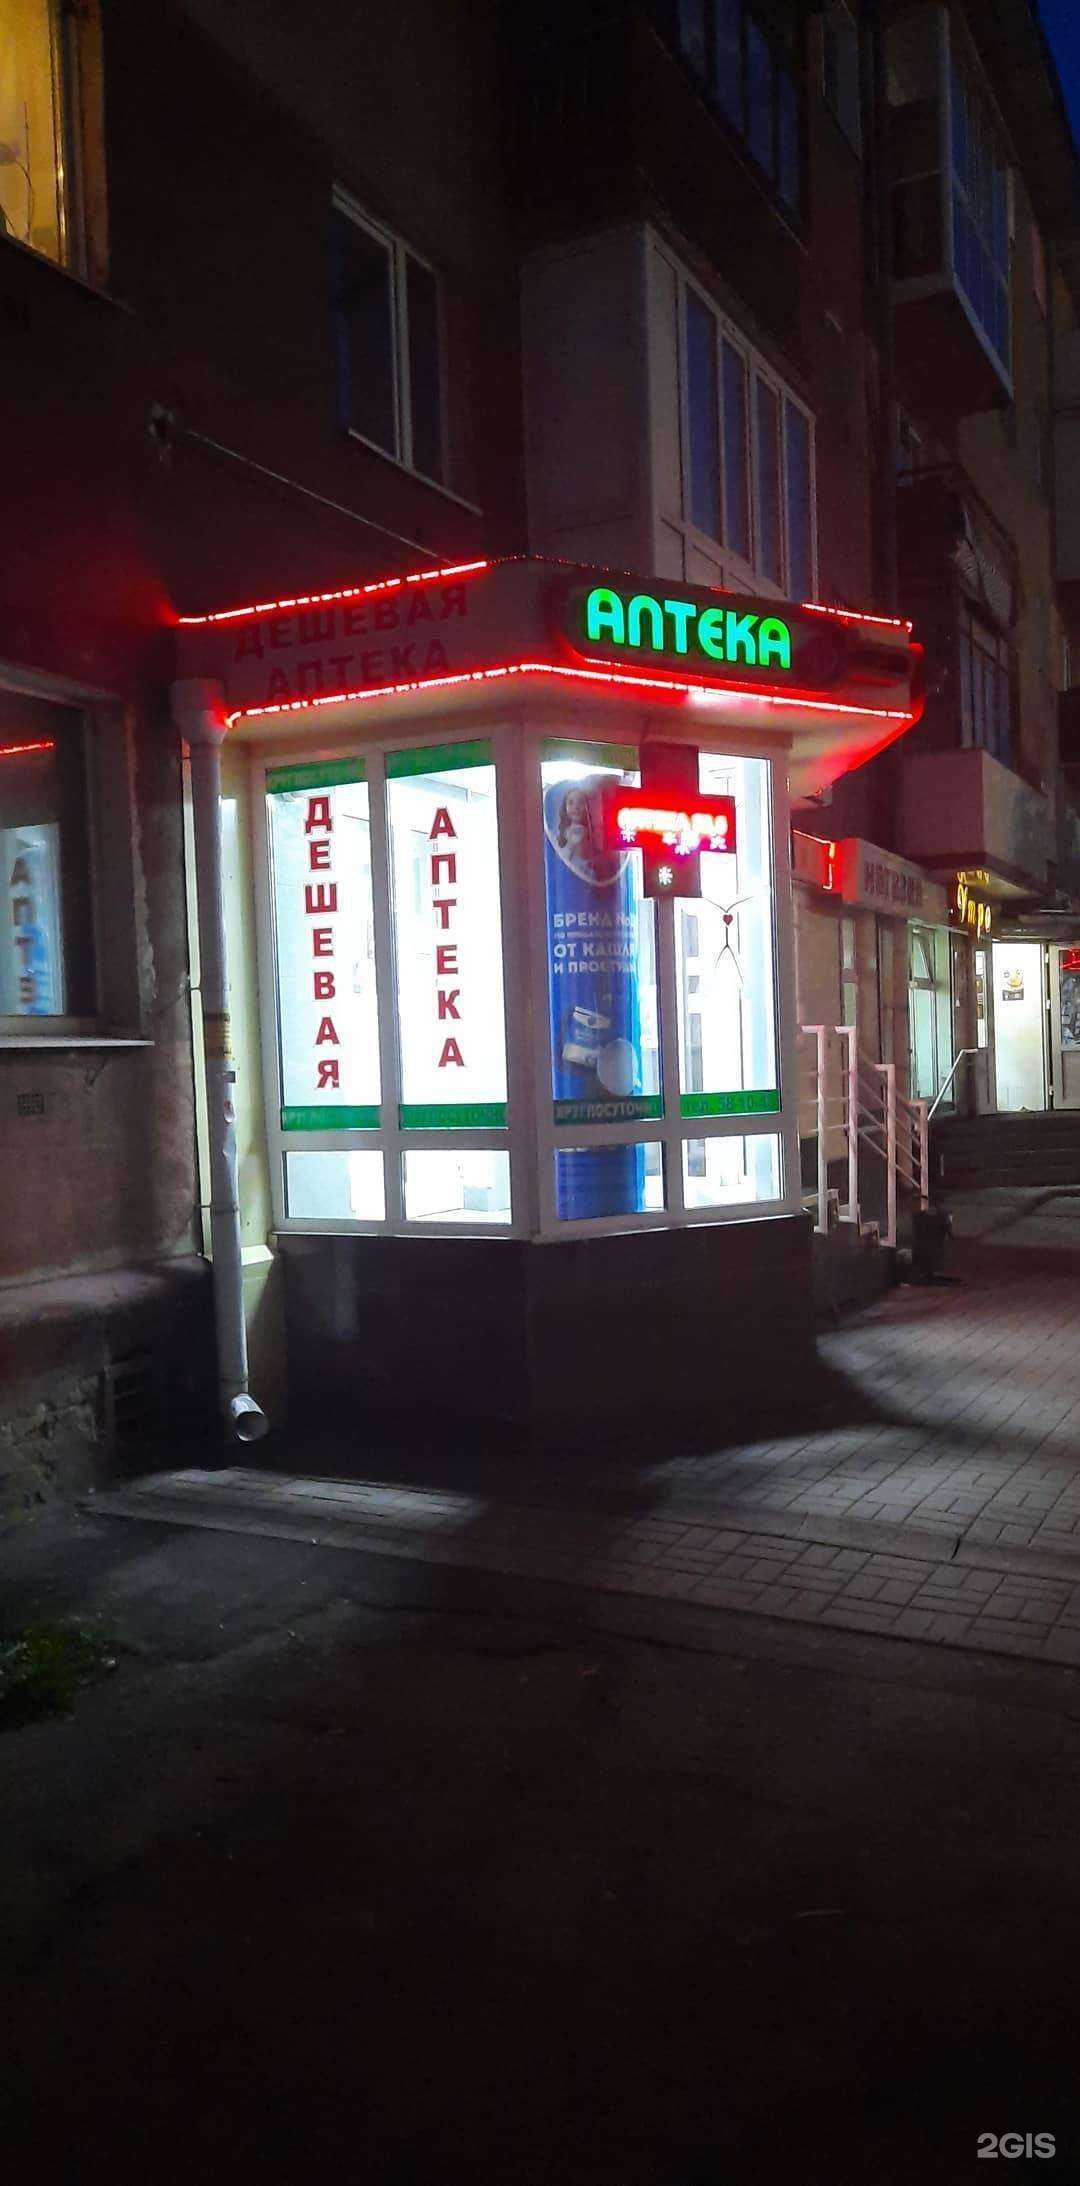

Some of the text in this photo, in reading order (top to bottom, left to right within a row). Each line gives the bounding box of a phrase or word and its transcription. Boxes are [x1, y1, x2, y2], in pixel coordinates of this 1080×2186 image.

[233, 582, 470, 664] ДЕШЕВАЯ
[586, 587, 793, 670] АПТЕКА
[268, 638, 451, 700] АПТЕКА
[304, 795, 340, 1089] ДЕШЕВАЯ
[428, 806, 466, 1069] АПТЕКА
[553, 943, 577, 958] ОТ
[554, 962, 564, 974] И
